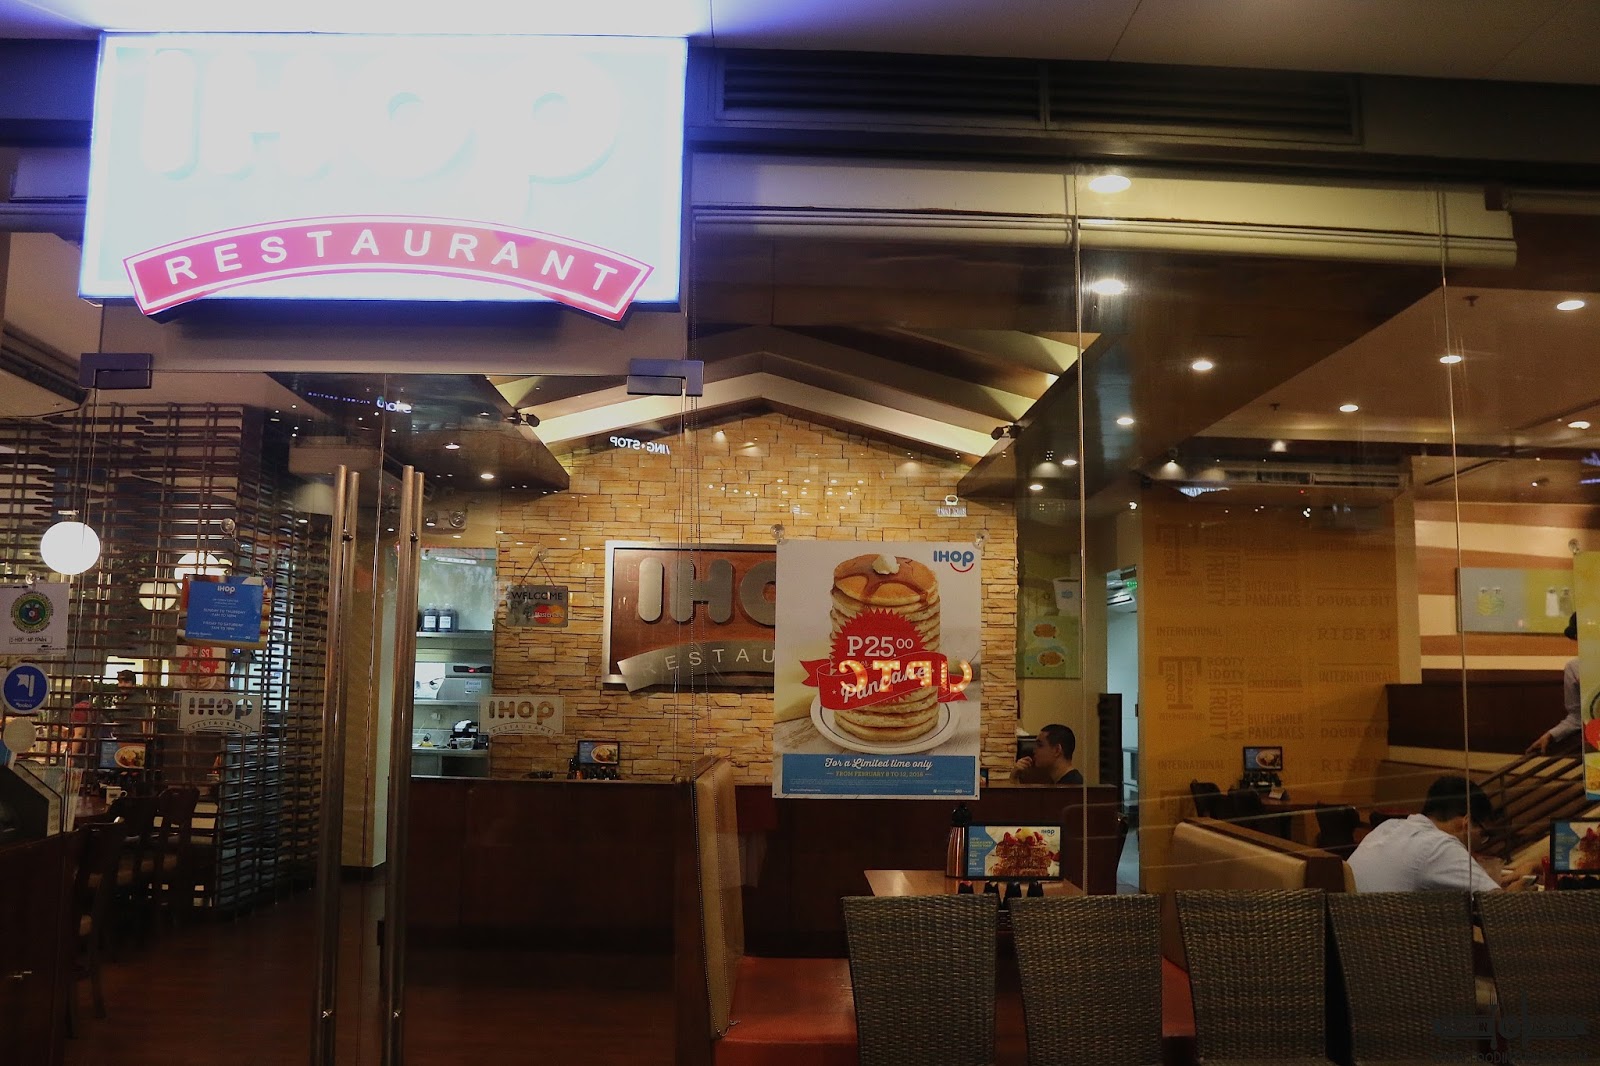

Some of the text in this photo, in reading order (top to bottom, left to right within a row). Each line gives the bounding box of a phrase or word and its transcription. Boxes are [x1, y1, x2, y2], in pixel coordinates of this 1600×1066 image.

[165, 228, 618, 291] RESTAURANT
[933, 550, 974, 567] IHOP
[511, 592, 563, 601] WELCOME
[638, 557, 776, 625] IHO
[189, 696, 253, 721] IHOP
[489, 700, 555, 725] IHOP
[192, 722, 248, 731] RESTAURANT
[492, 724, 551, 734] RESTAURANT
[1248, 727, 1304, 740] PANCAKES
[825, 757, 843, 768] For
[852, 758, 890, 770] Limited
[890, 758, 912, 768] time
[912, 758, 931, 770] only
